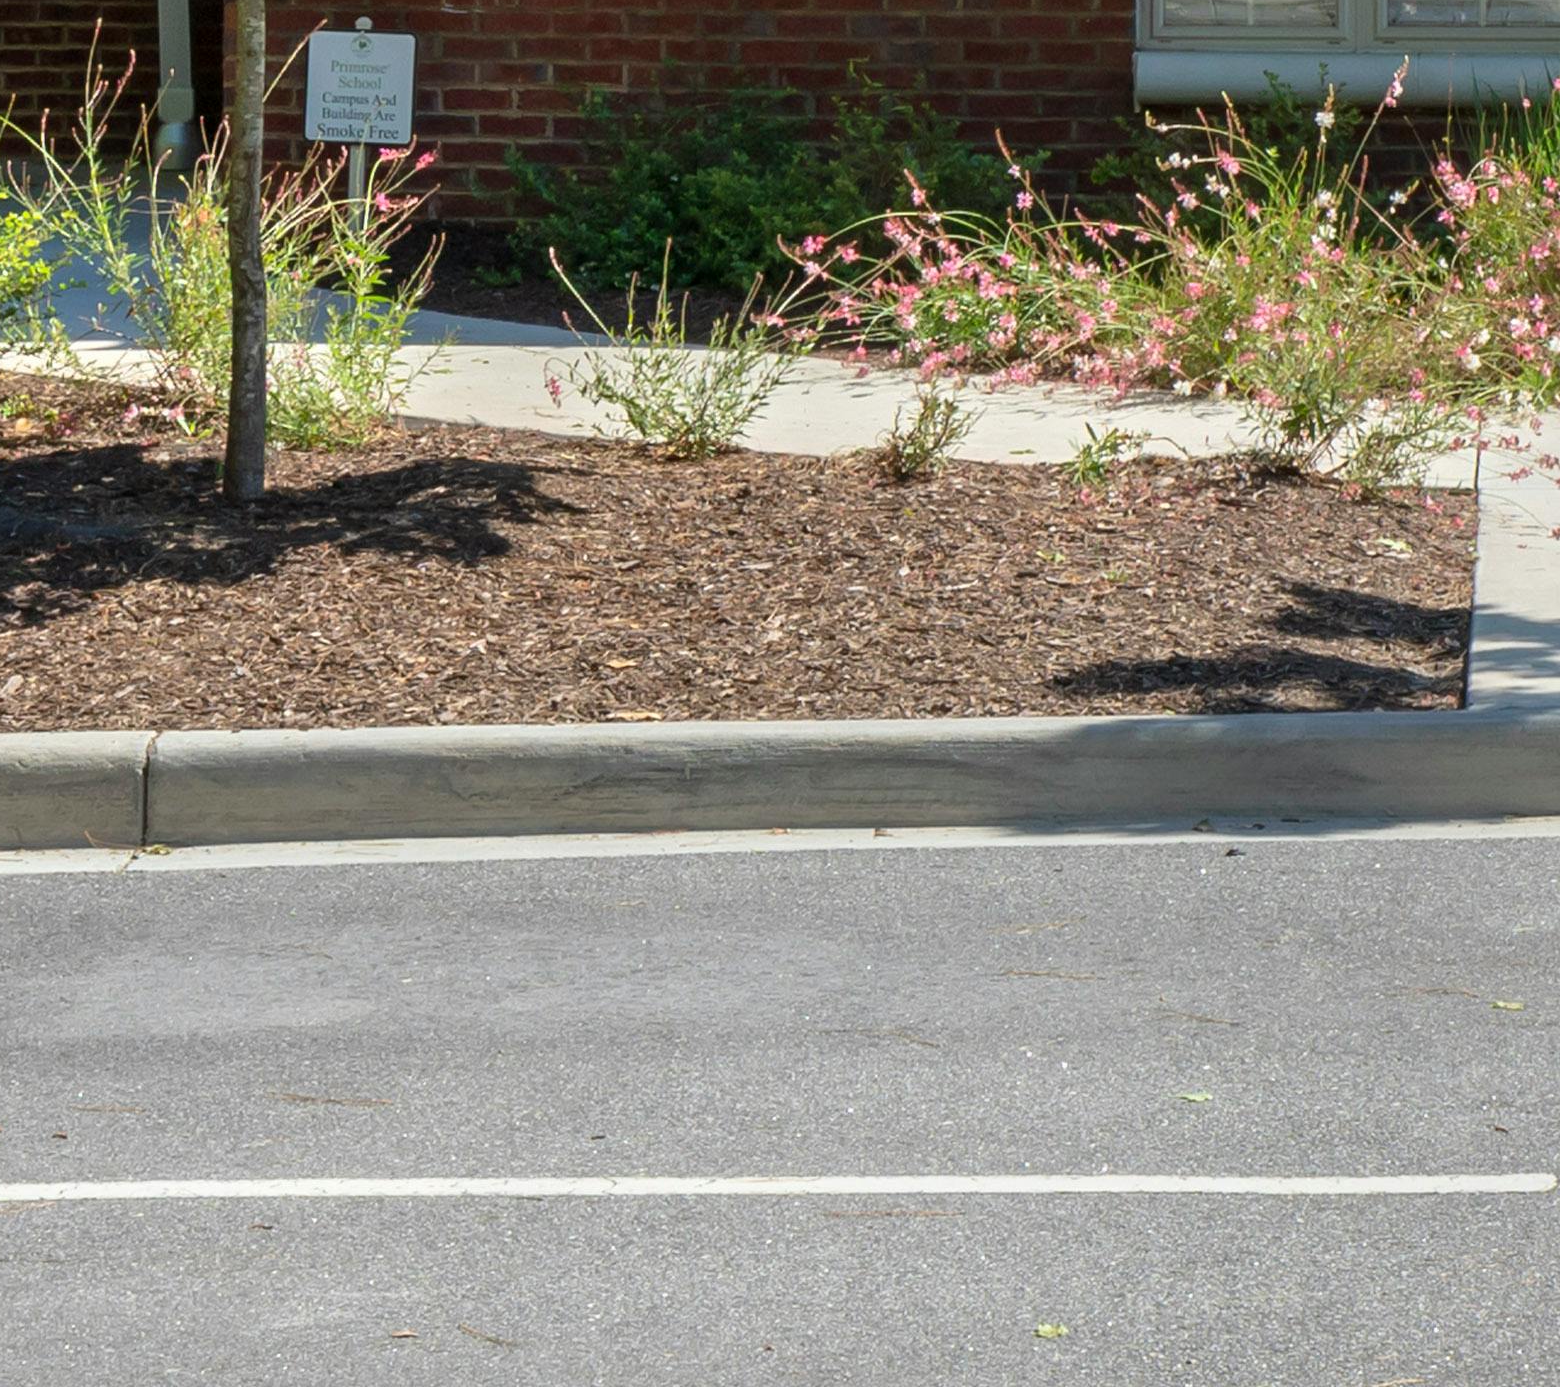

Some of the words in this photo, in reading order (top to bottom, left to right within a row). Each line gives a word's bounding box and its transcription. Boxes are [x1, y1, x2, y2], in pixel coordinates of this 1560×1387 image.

[330, 59, 388, 74] Primrose
[338, 76, 382, 89] School
[322, 91, 369, 107] Campus
[372, 95, 397, 106] And
[322, 108, 372, 123] Building
[374, 111, 396, 122] Are
[317, 123, 365, 138] Smoke
[369, 125, 399, 139] Free
